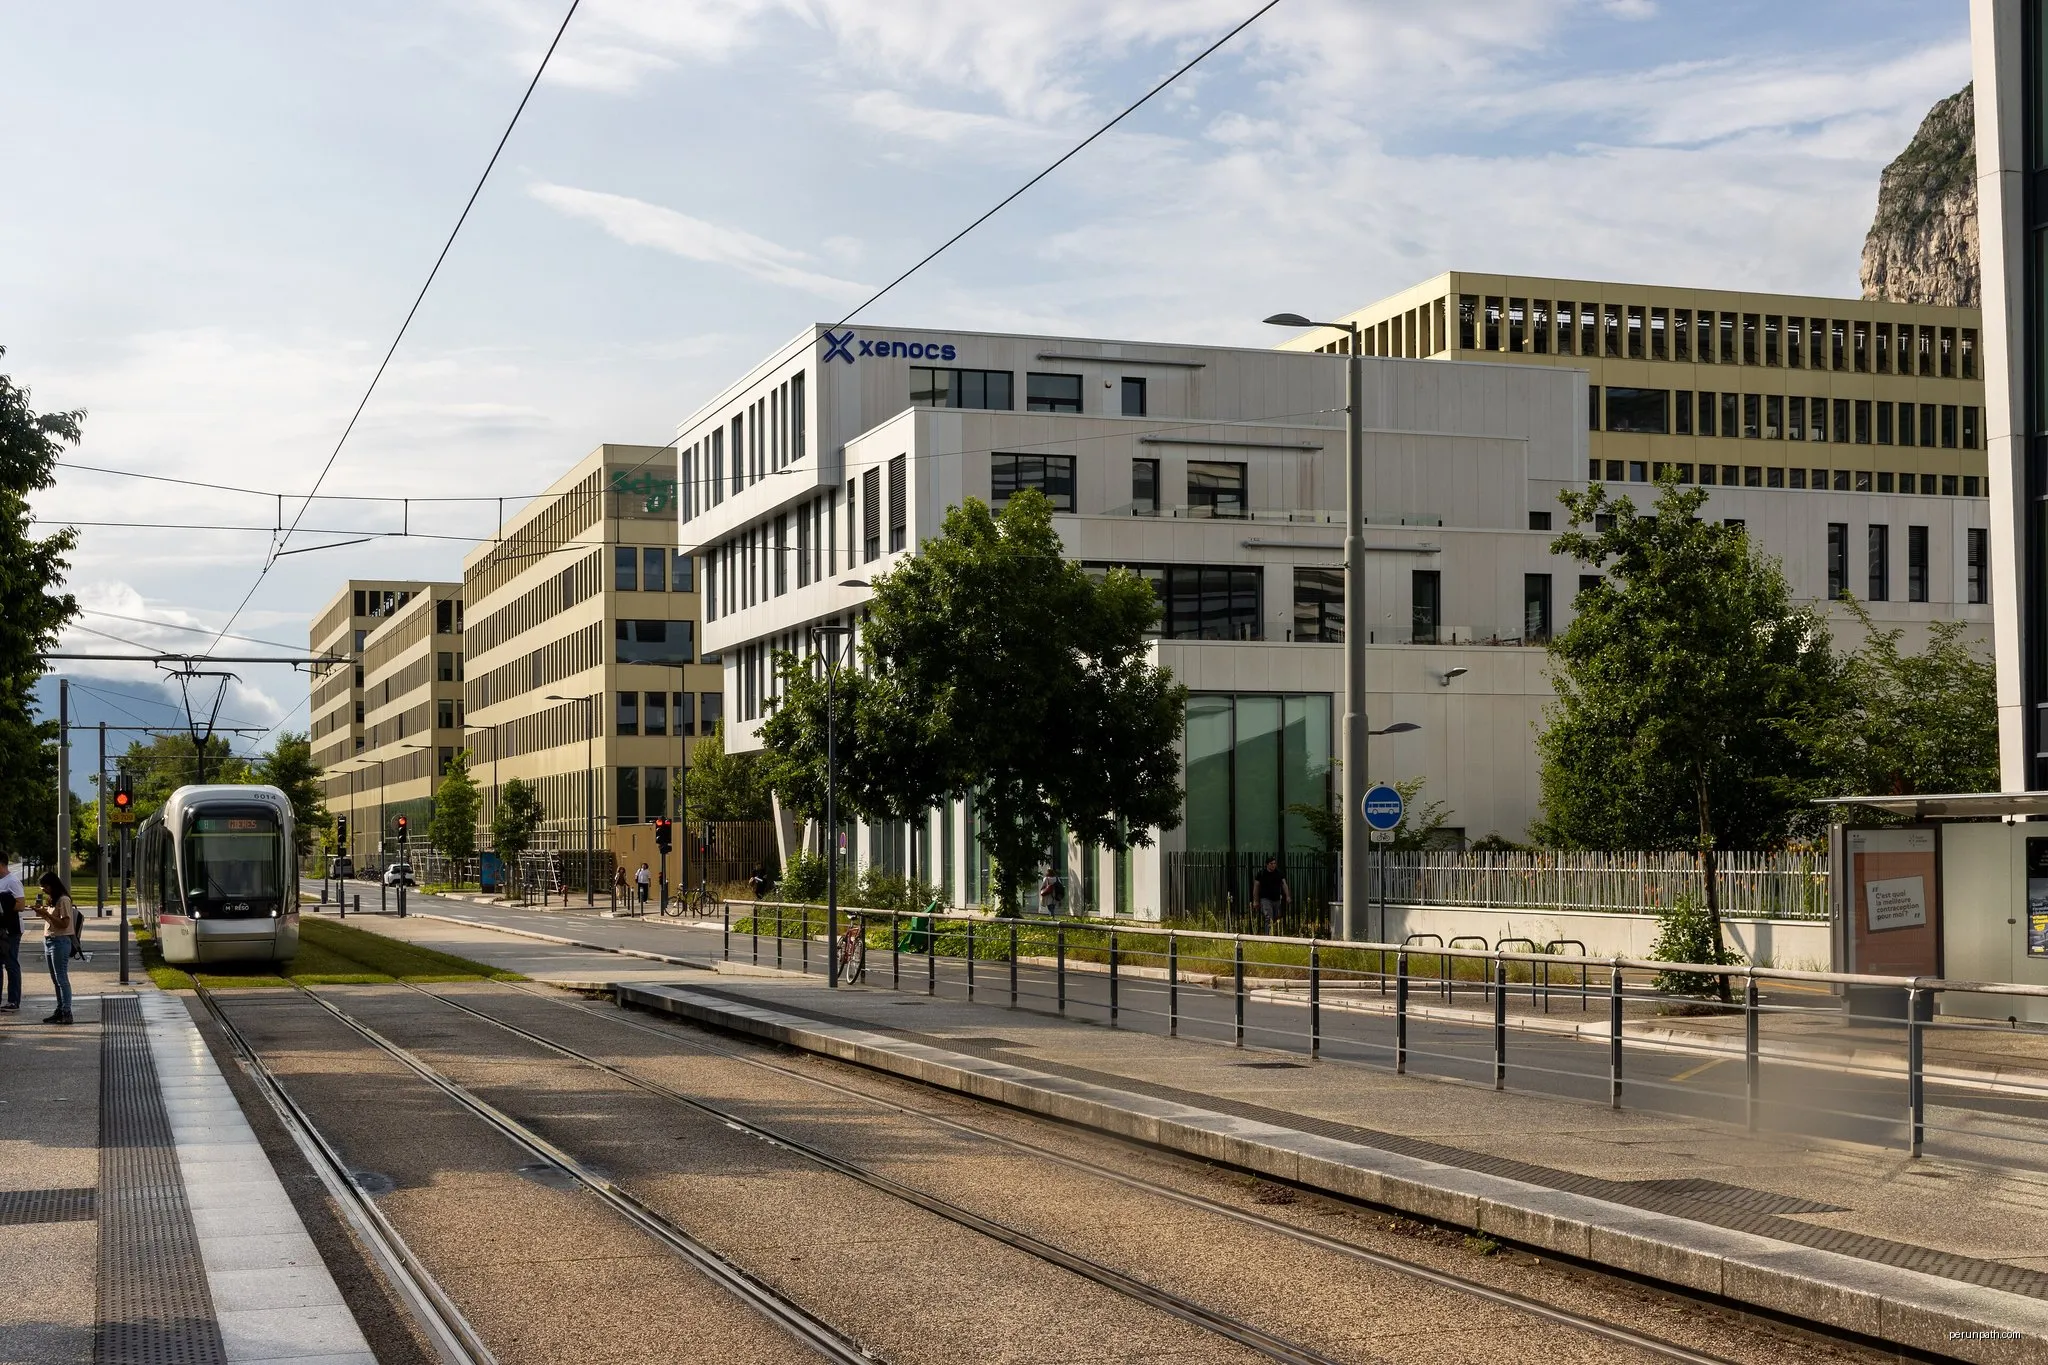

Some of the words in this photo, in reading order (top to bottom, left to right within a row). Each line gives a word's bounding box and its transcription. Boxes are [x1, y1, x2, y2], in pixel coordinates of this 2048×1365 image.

[859, 340, 957, 361] xenocs
[1876, 903, 1920, 913] contraception
[1877, 914, 1892, 922] pour
